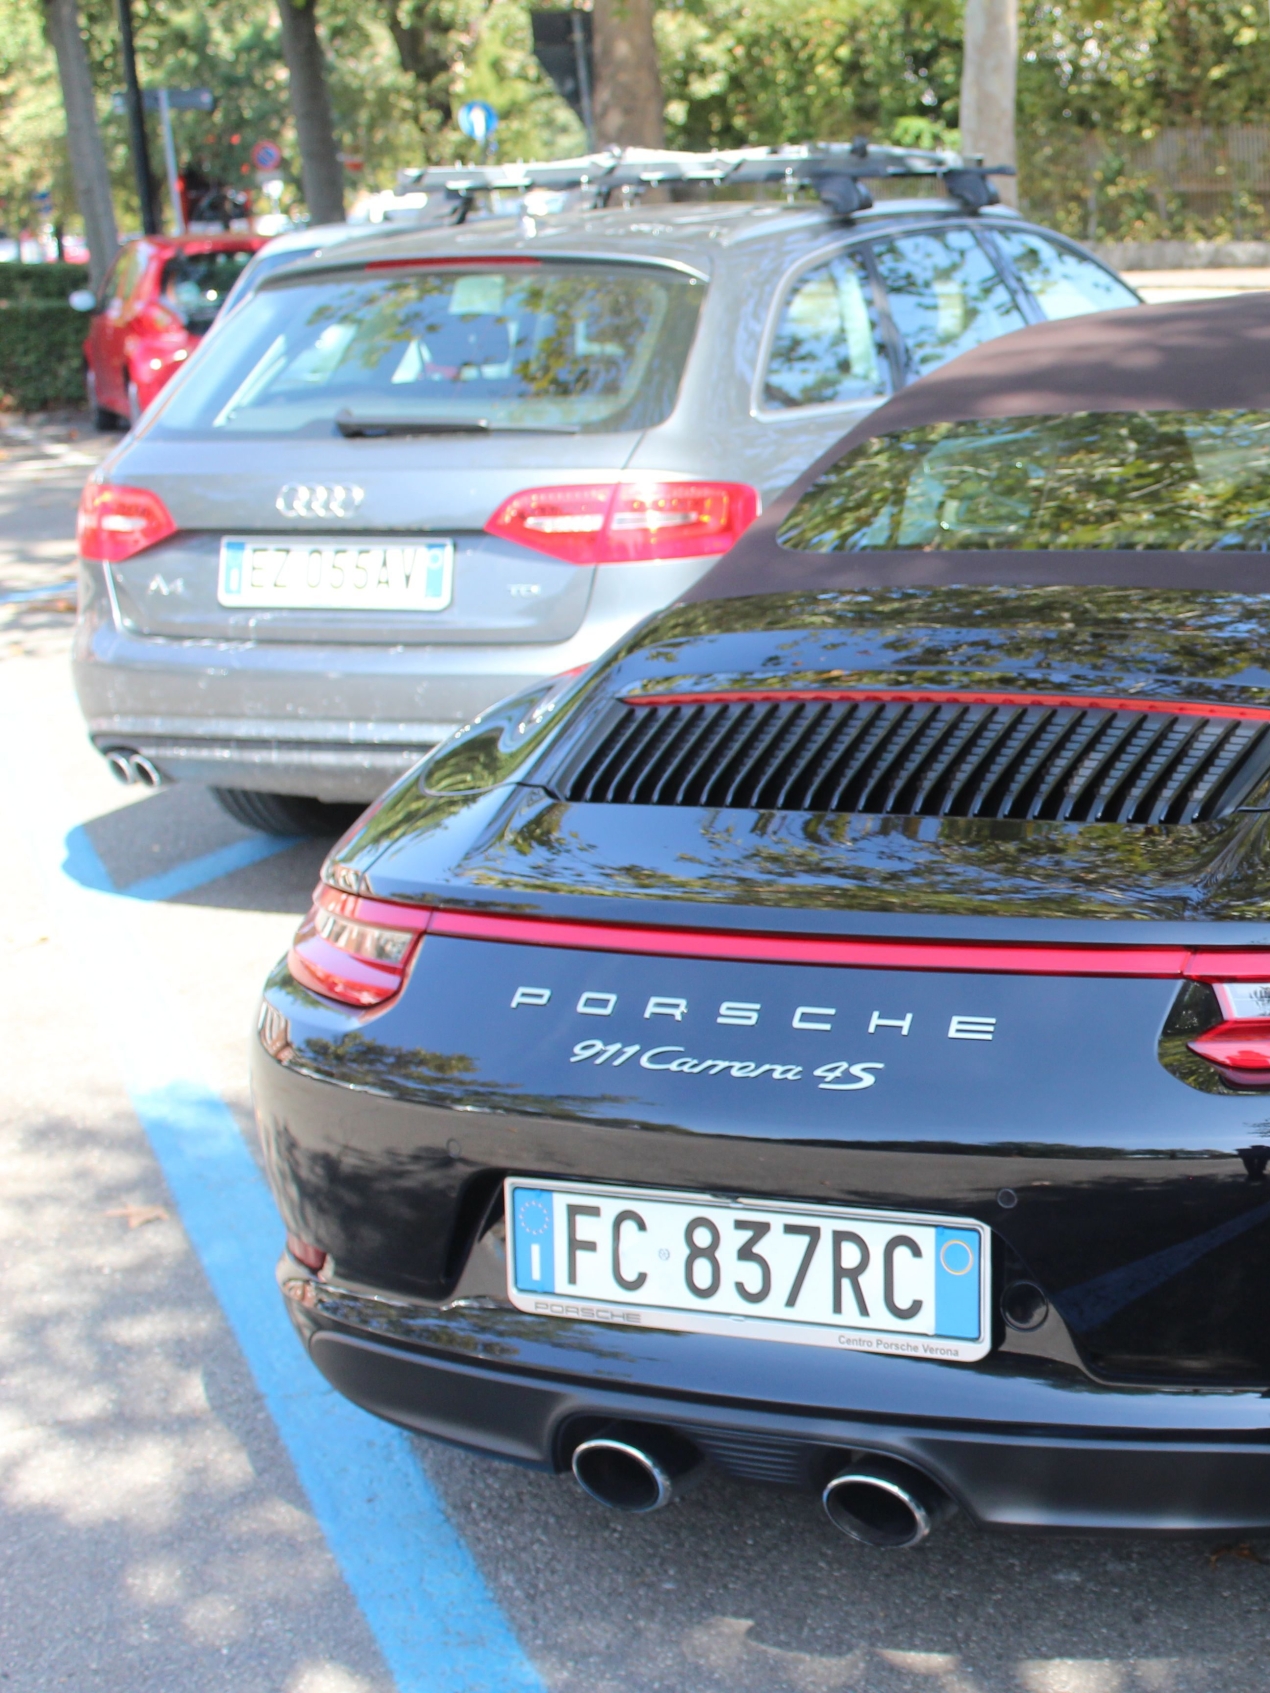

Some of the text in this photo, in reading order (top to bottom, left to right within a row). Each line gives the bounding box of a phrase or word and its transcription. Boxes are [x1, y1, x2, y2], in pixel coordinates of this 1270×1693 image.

[250, 548, 417, 589] EZ 055AV
[510, 986, 997, 1040] PORSCHE
[569, 1039, 885, 1090] 911 Carrera 4S
[566, 1203, 923, 1320] FC 837RC
[534, 1301, 642, 1324] PORSCHE
[838, 1335, 960, 1358] Centro Porsche Verona
